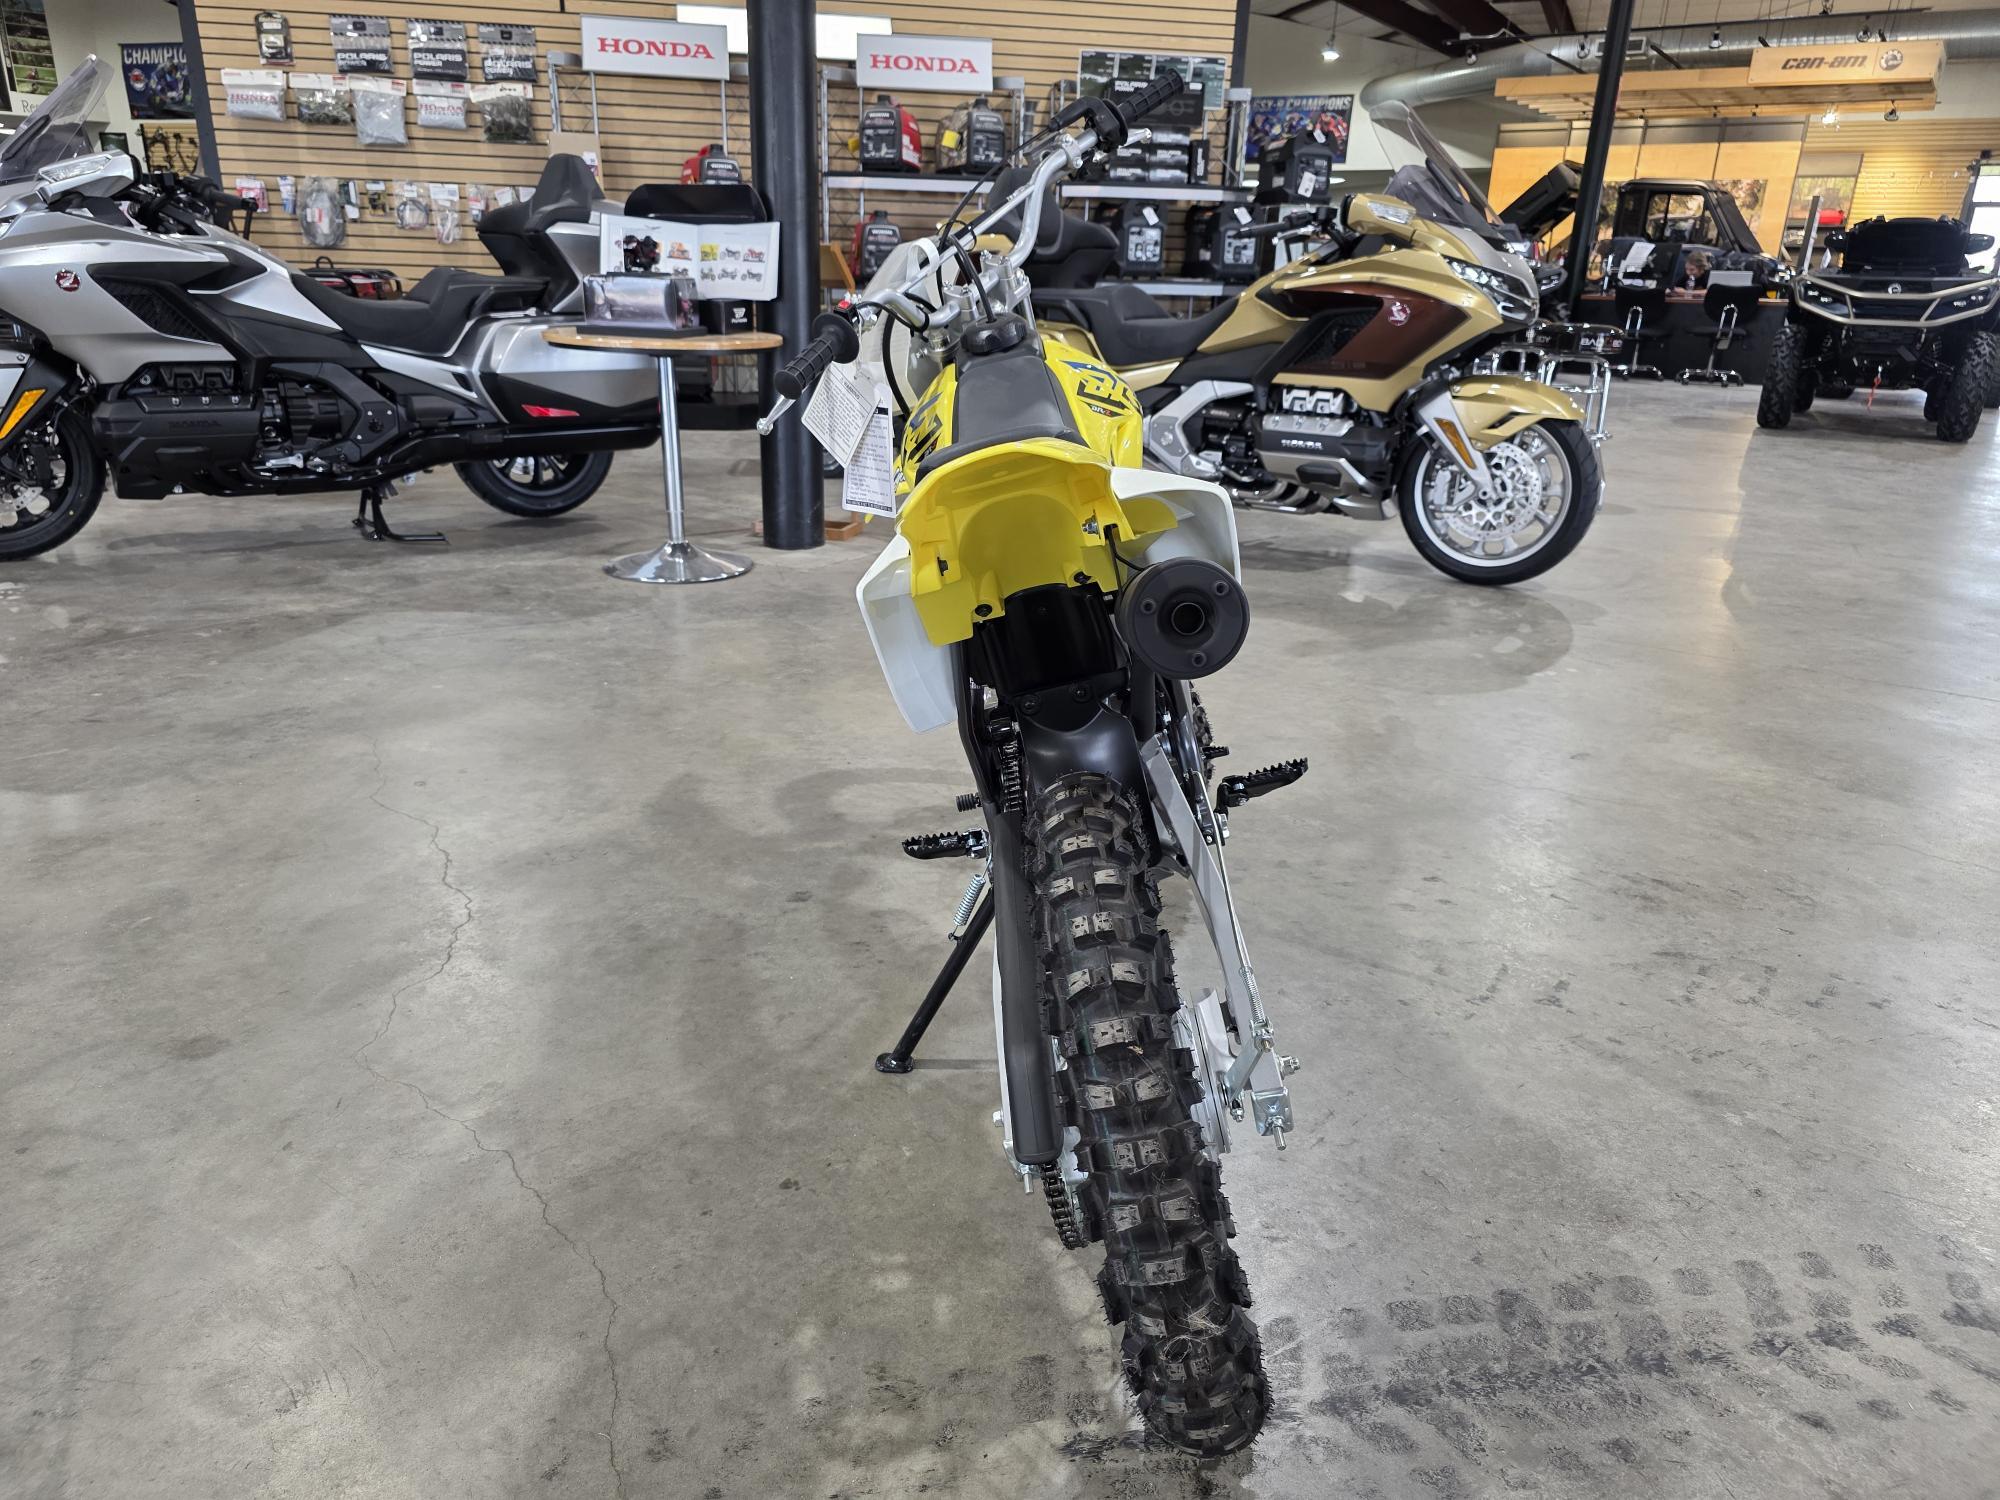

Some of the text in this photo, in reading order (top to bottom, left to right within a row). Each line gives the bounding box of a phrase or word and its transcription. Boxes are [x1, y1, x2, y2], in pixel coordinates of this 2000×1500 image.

[124, 47, 187, 65] CHAMPIO
[597, 37, 714, 60] HONDA
[413, 52, 463, 62] POLARIS
[870, 54, 979, 74] HONDA
[1781, 55, 1867, 70] can-am
[230, 94, 277, 104] HONDA
[1285, 96, 1351, 111] CHAMPIONS
[417, 103, 464, 113] HONDA
[1281, 439, 1324, 451] HONDA
